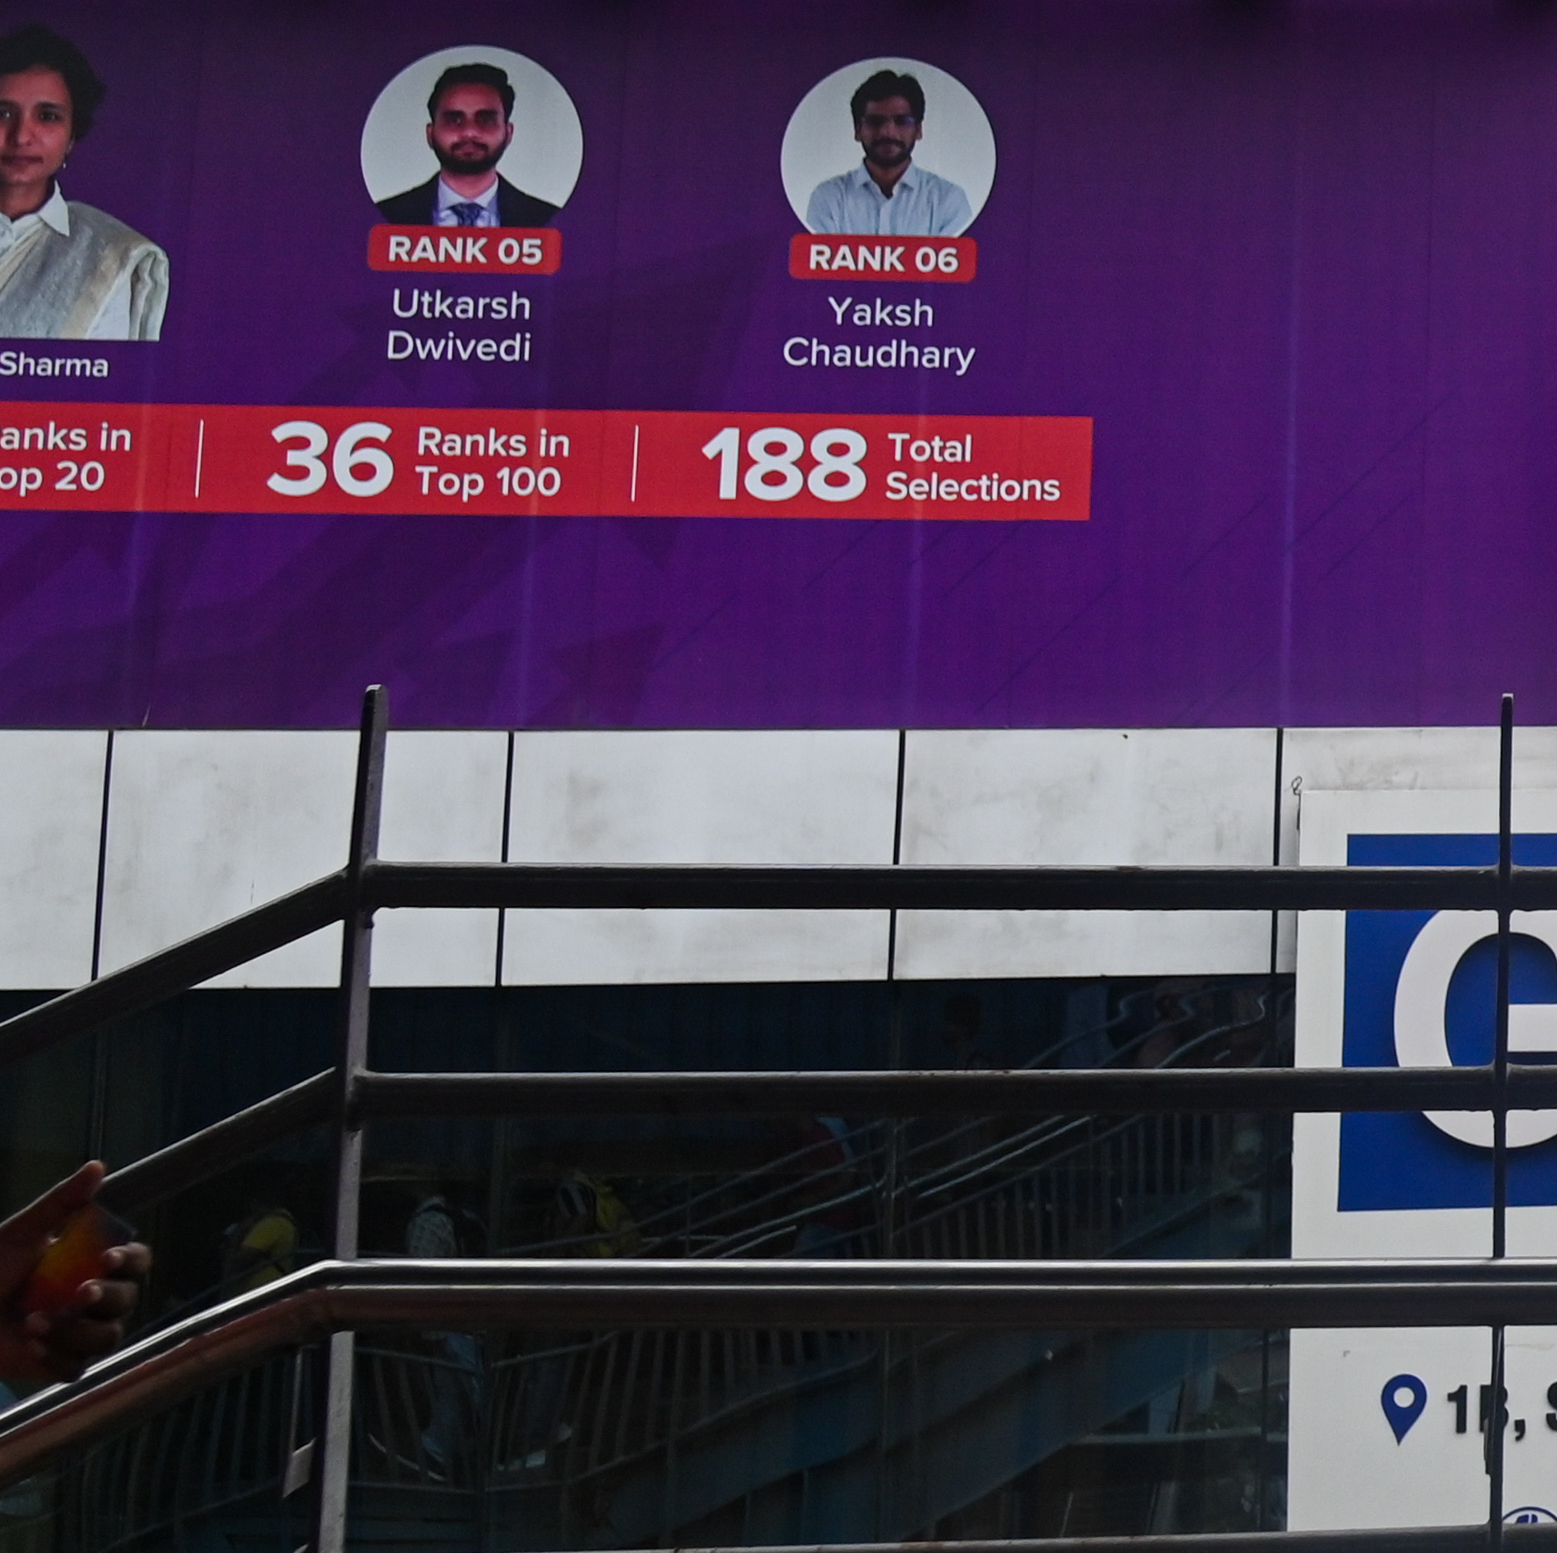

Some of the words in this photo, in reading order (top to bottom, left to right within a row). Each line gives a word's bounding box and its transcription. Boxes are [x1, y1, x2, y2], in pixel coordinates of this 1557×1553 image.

[388, 235, 488, 263] RANK
[498, 238, 543, 265] 05
[809, 244, 906, 272] RANK
[915, 246, 959, 273] 06
[393, 288, 530, 320] Utkarsh
[828, 296, 934, 327] Yaksh
[387, 330, 531, 362] Dwivedi
[783, 336, 976, 376] Chaudhary
[0, 351, 109, 377] Sharma
[100, 422, 131, 451] in
[418, 426, 527, 457] Ranks
[539, 428, 569, 457] in
[887, 433, 972, 462] Total
[267, 420, 394, 497] 36
[702, 427, 867, 502] 188
[55, 460, 105, 491] 20
[415, 465, 484, 503] Top
[496, 466, 561, 496] 100
[885, 471, 1061, 502] Selections
